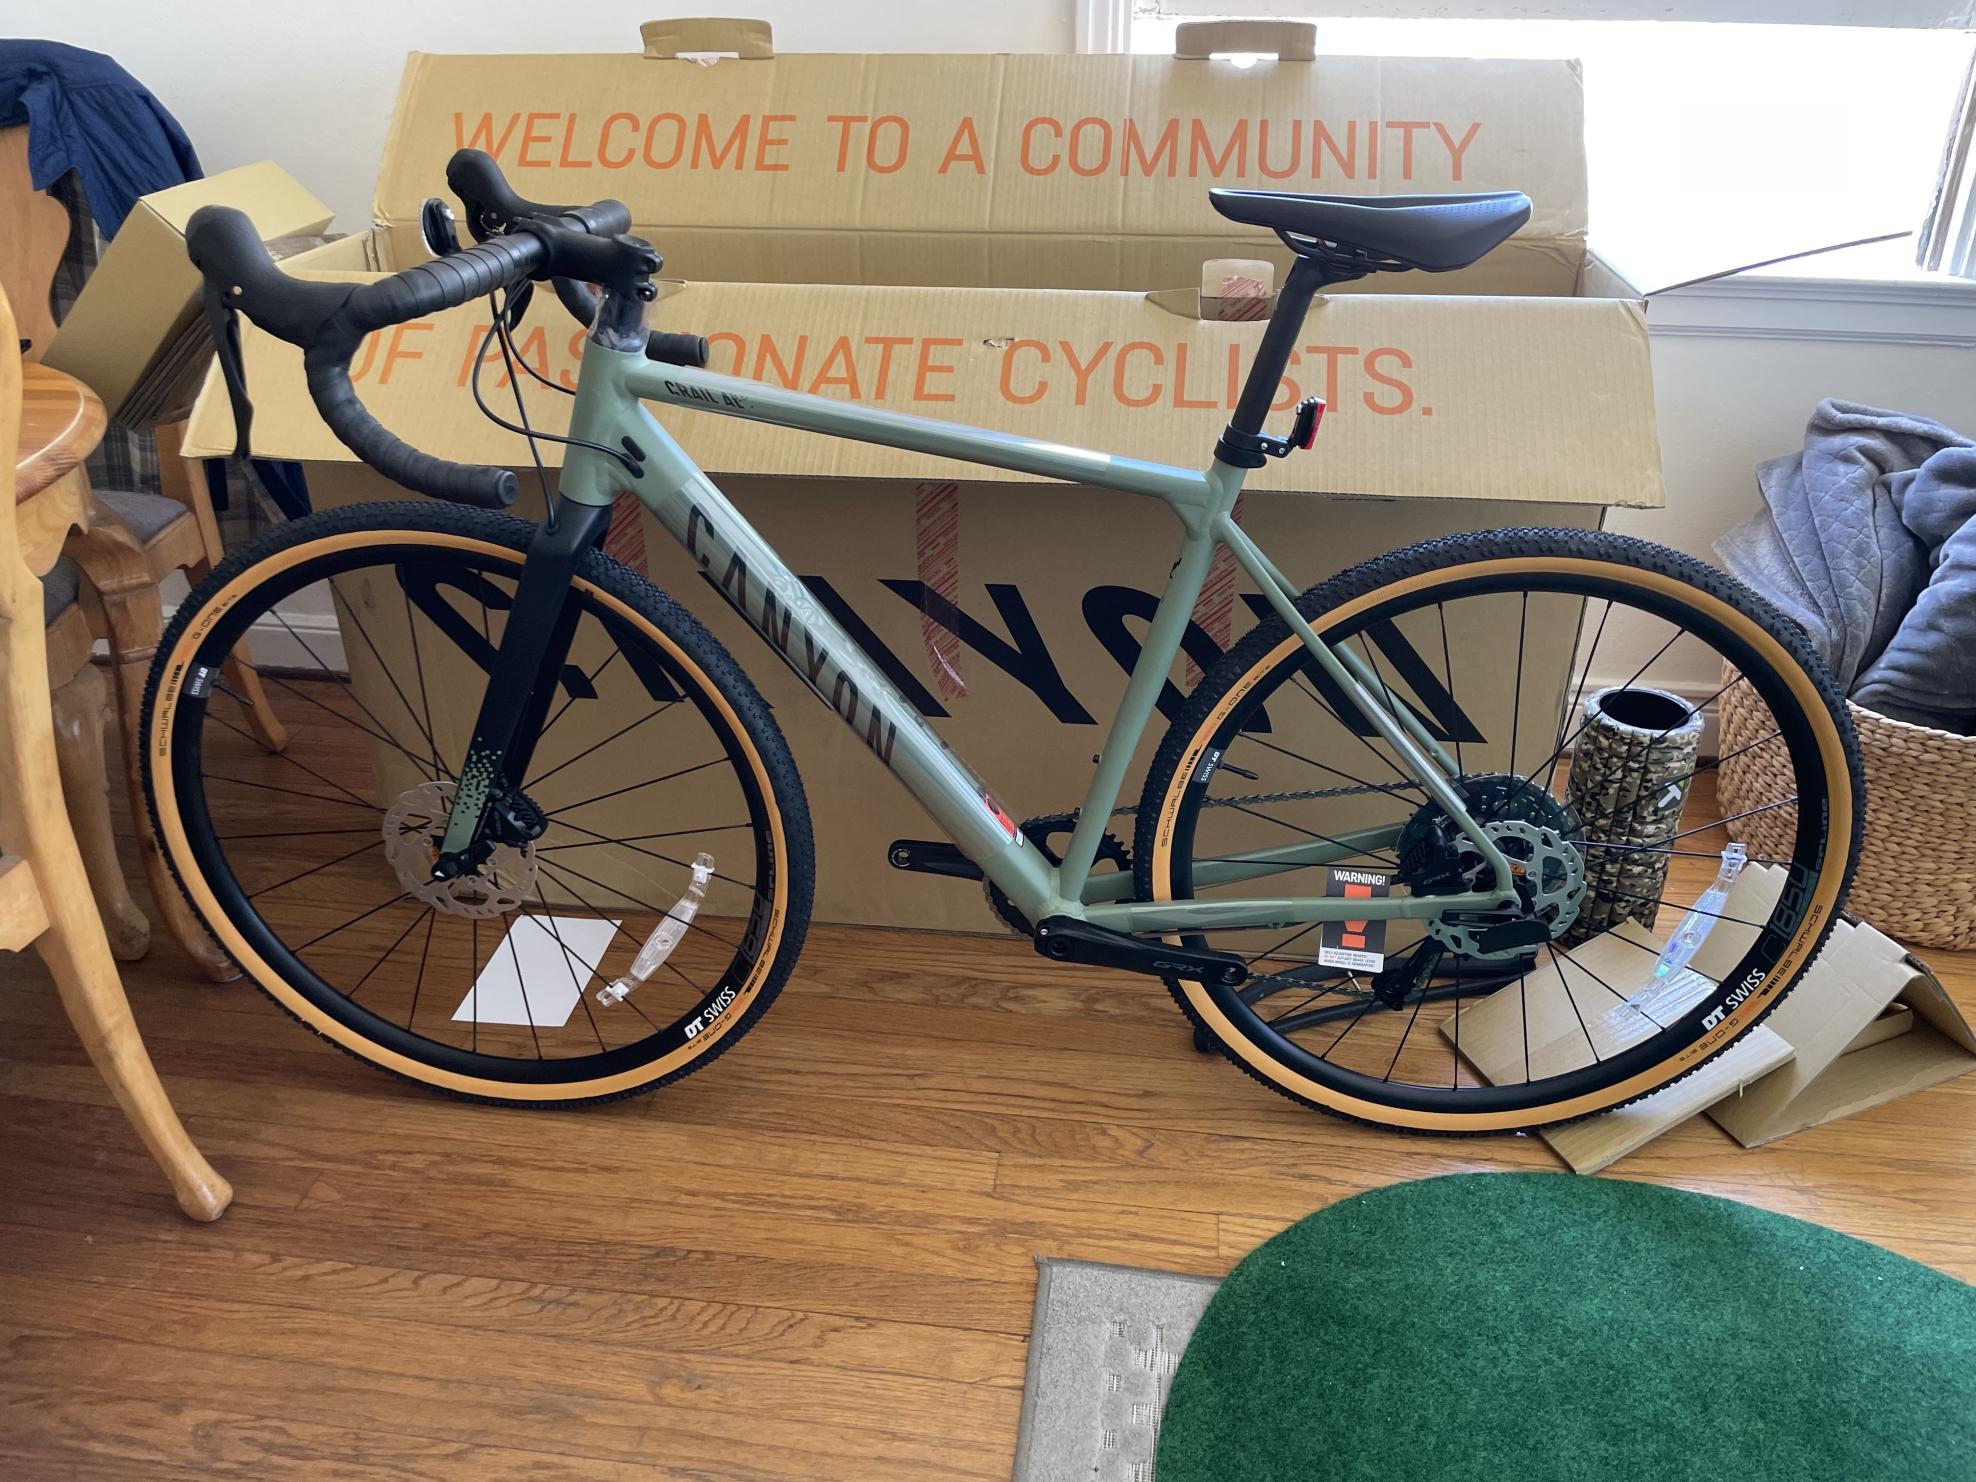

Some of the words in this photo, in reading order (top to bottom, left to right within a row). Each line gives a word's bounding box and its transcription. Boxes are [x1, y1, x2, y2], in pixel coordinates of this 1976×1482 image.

[454, 112, 797, 173] WELCOME
[827, 114, 910, 174] TO
[937, 116, 986, 174] A
[1019, 116, 1483, 181] COMMUNITY
[456, 323, 964, 402] PASONATE
[664, 379, 720, 404] GRAIL
[192, 606, 223, 640] G-ONE
[394, 563, 1488, 744] CNYON
[686, 502, 898, 768] CANYON
[159, 683, 177, 757] SCHWALBE
[1217, 681, 1253, 721] G-ONE
[1161, 772, 1188, 848] SCHWALBE
[1333, 869, 1386, 887] WARNING!
[757, 908, 780, 975] SCHWALBE
[1152, 960, 1205, 974] GRX
[1778, 904, 1824, 977] SCHWALBE
[684, 1016, 705, 1040] DT
[703, 985, 737, 1023] SWISS
[702, 1012, 732, 1042] G-ONE
[1701, 1004, 1726, 1031] DT
[1725, 967, 1766, 1010] SWISS
[1699, 1017, 1739, 1051] G-ONE
